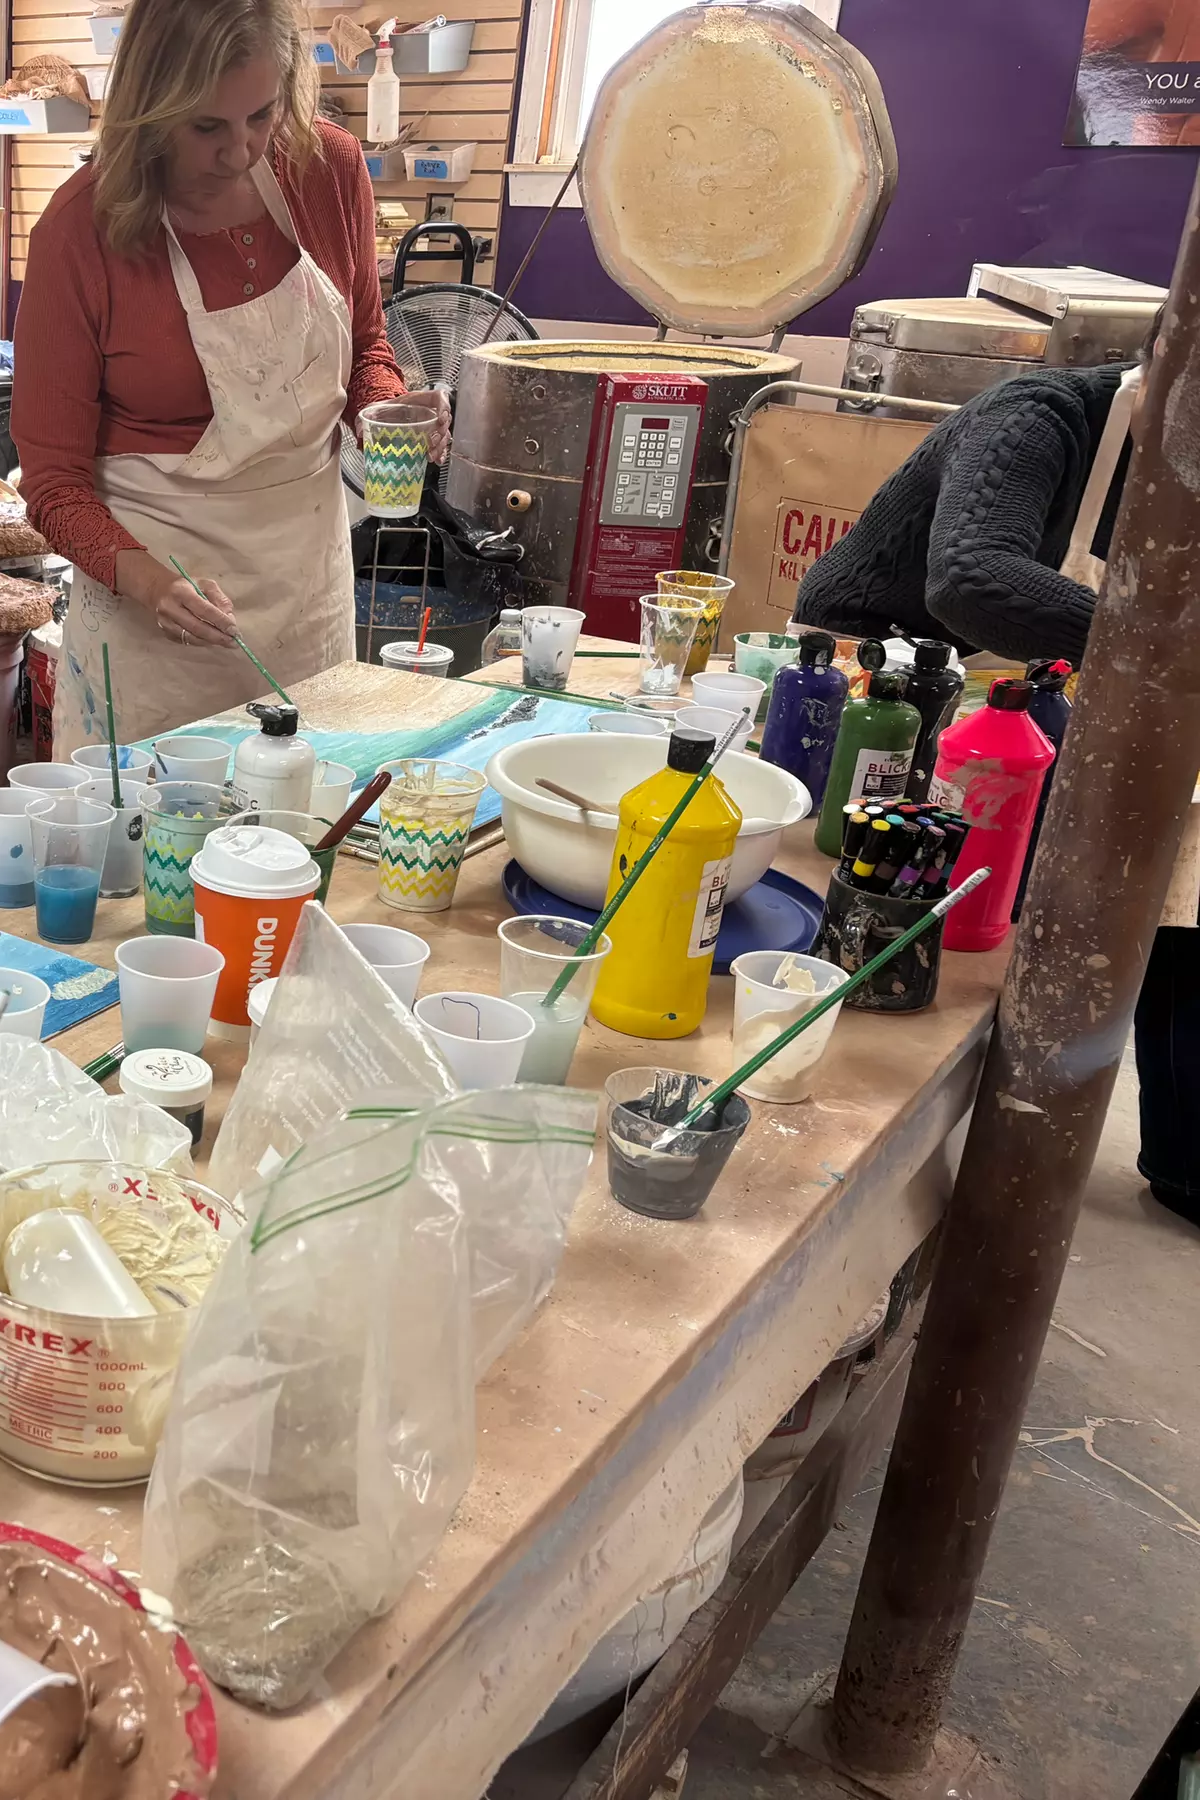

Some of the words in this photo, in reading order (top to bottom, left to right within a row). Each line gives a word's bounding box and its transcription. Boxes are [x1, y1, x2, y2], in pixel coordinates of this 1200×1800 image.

[1146, 73, 1189, 89] YOU
[647, 385, 688, 397] SKUTT
[95, 1361, 148, 1372] 1000mL
[98, 1382, 126, 1391] 800
[96, 1405, 123, 1414] 600
[9, 1415, 53, 1440] METRIC
[95, 1426, 122, 1435] 400
[93, 1451, 118, 1460] 200
